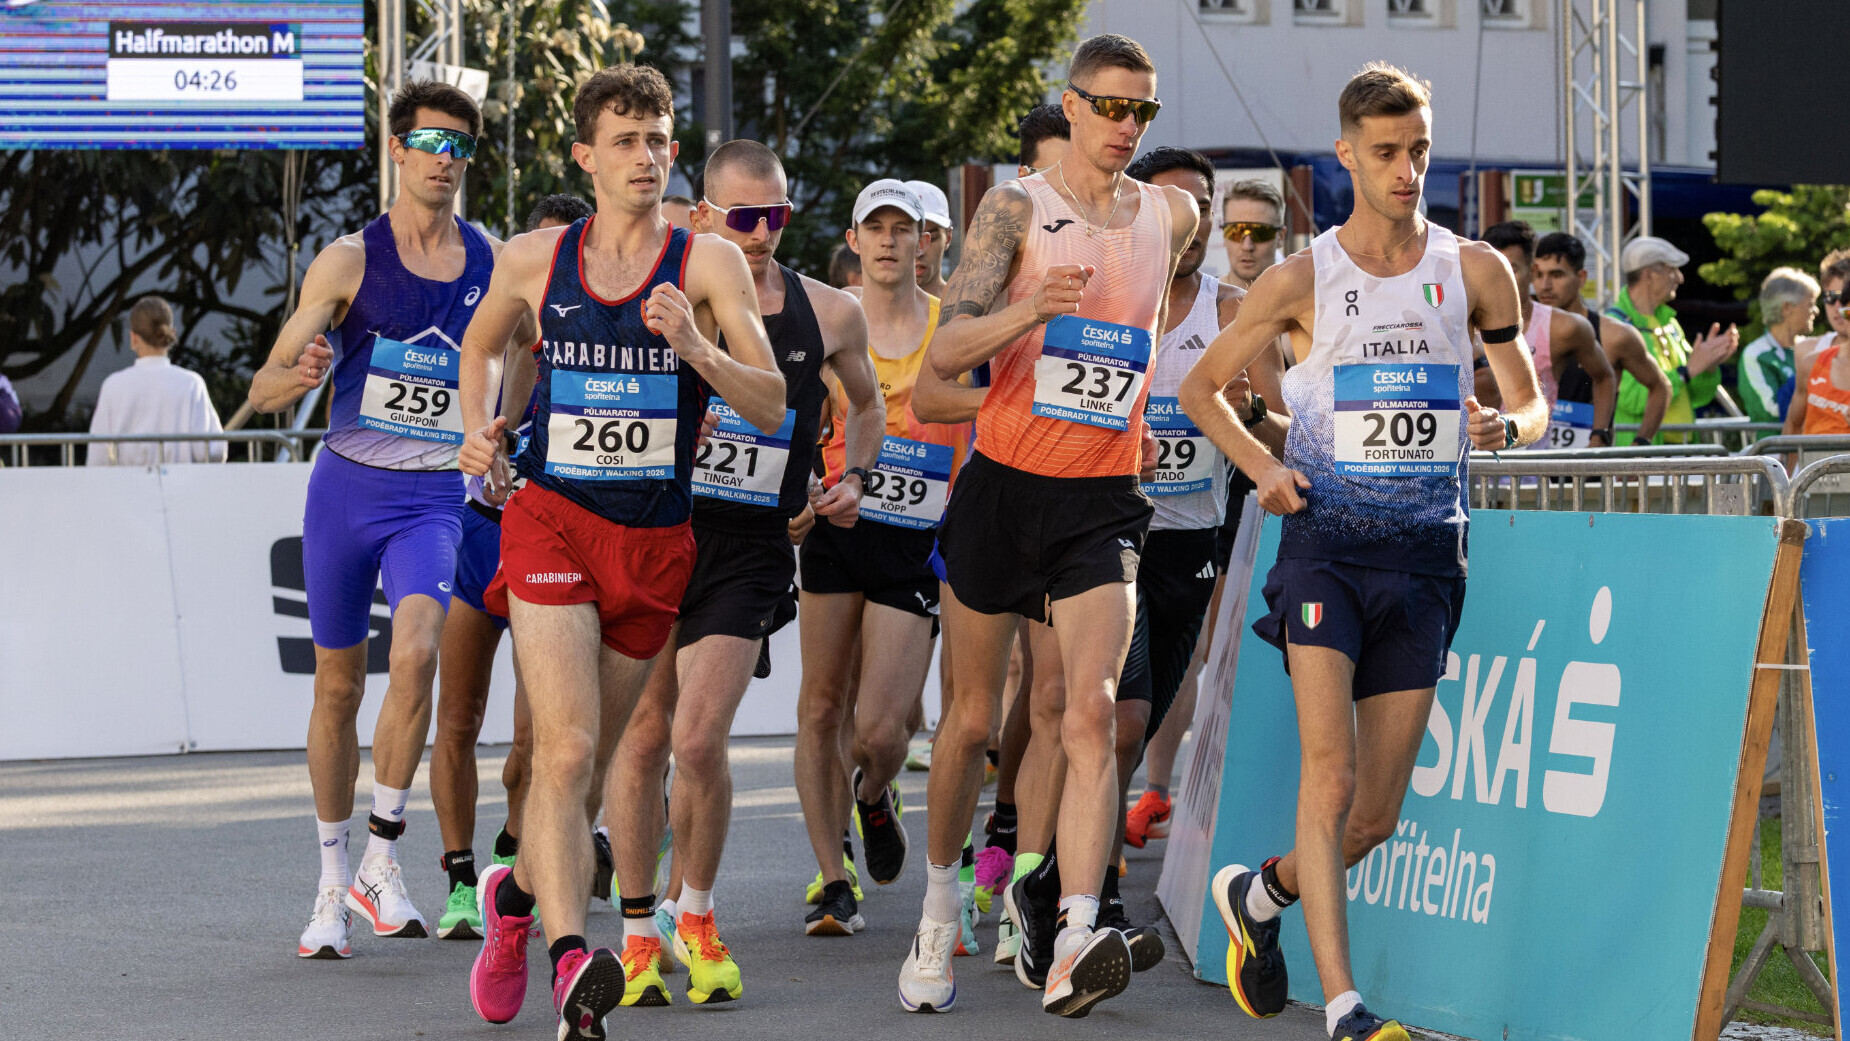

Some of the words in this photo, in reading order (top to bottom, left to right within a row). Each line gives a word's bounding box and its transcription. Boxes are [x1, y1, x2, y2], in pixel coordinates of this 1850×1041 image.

[115, 27, 269, 54] Halfmarathon
[272, 31, 295, 54] M
[174, 69, 237, 91] 04:26
[1082, 324, 1119, 342] ČESKÁ
[1373, 322, 1423, 331] FRECCIAROSSA
[1081, 338, 1114, 350] spořitelna
[1363, 339, 1430, 358] ITALIA
[404, 349, 437, 365] ČESKÁ
[1078, 353, 1130, 367] PŮLMARATON
[400, 374, 446, 387] PŮLMARATON
[1061, 362, 1135, 402] 237
[1373, 369, 1415, 384] ČESKÁ
[585, 377, 625, 393] ČESKÁ
[1373, 384, 1411, 393] spořitelna
[384, 382, 451, 417] 259
[584, 393, 621, 401] spořitelna
[584, 407, 640, 417] PŮLMARATON
[708, 402, 741, 418] ČESK
[1080, 398, 1113, 413] LINKE
[1373, 401, 1428, 409] PŮLMARATON
[390, 412, 438, 428] GIUPPONI
[1040, 406, 1089, 421] PODĚBRADY
[1090, 414, 1125, 428] WALKING
[365, 419, 408, 433] PODĚBRADY
[410, 429, 440, 439] WALKING
[573, 418, 650, 454] 260
[1362, 412, 1437, 447] 209
[712, 431, 757, 443] LMARATON
[882, 440, 915, 456] ČESKÁ
[1158, 439, 1196, 470] 29
[1365, 449, 1434, 459] FORTUNATO
[596, 455, 624, 465] COSI
[694, 442, 759, 478] 221
[553, 465, 604, 477] PODĚBRADY
[605, 469, 644, 477] WALKING
[645, 468, 666, 476] 2026
[878, 463, 924, 476] PŮLMARATON
[1156, 471, 1185, 481] TADO
[1344, 464, 1397, 473] PODĚBRADY
[1399, 465, 1432, 473] WALKING
[1433, 465, 1450, 473] 2026
[703, 472, 744, 487] TINGAY
[691, 484, 717, 495] BRADY
[718, 489, 752, 501] WALKING
[866, 471, 928, 505] 239
[1157, 484, 1190, 493] WALKING
[880, 502, 907, 513] KÖPP
[888, 516, 917, 526] WALKING
[526, 572, 582, 584] CARABINIERI
[1411, 619, 1546, 809] SKÁ
